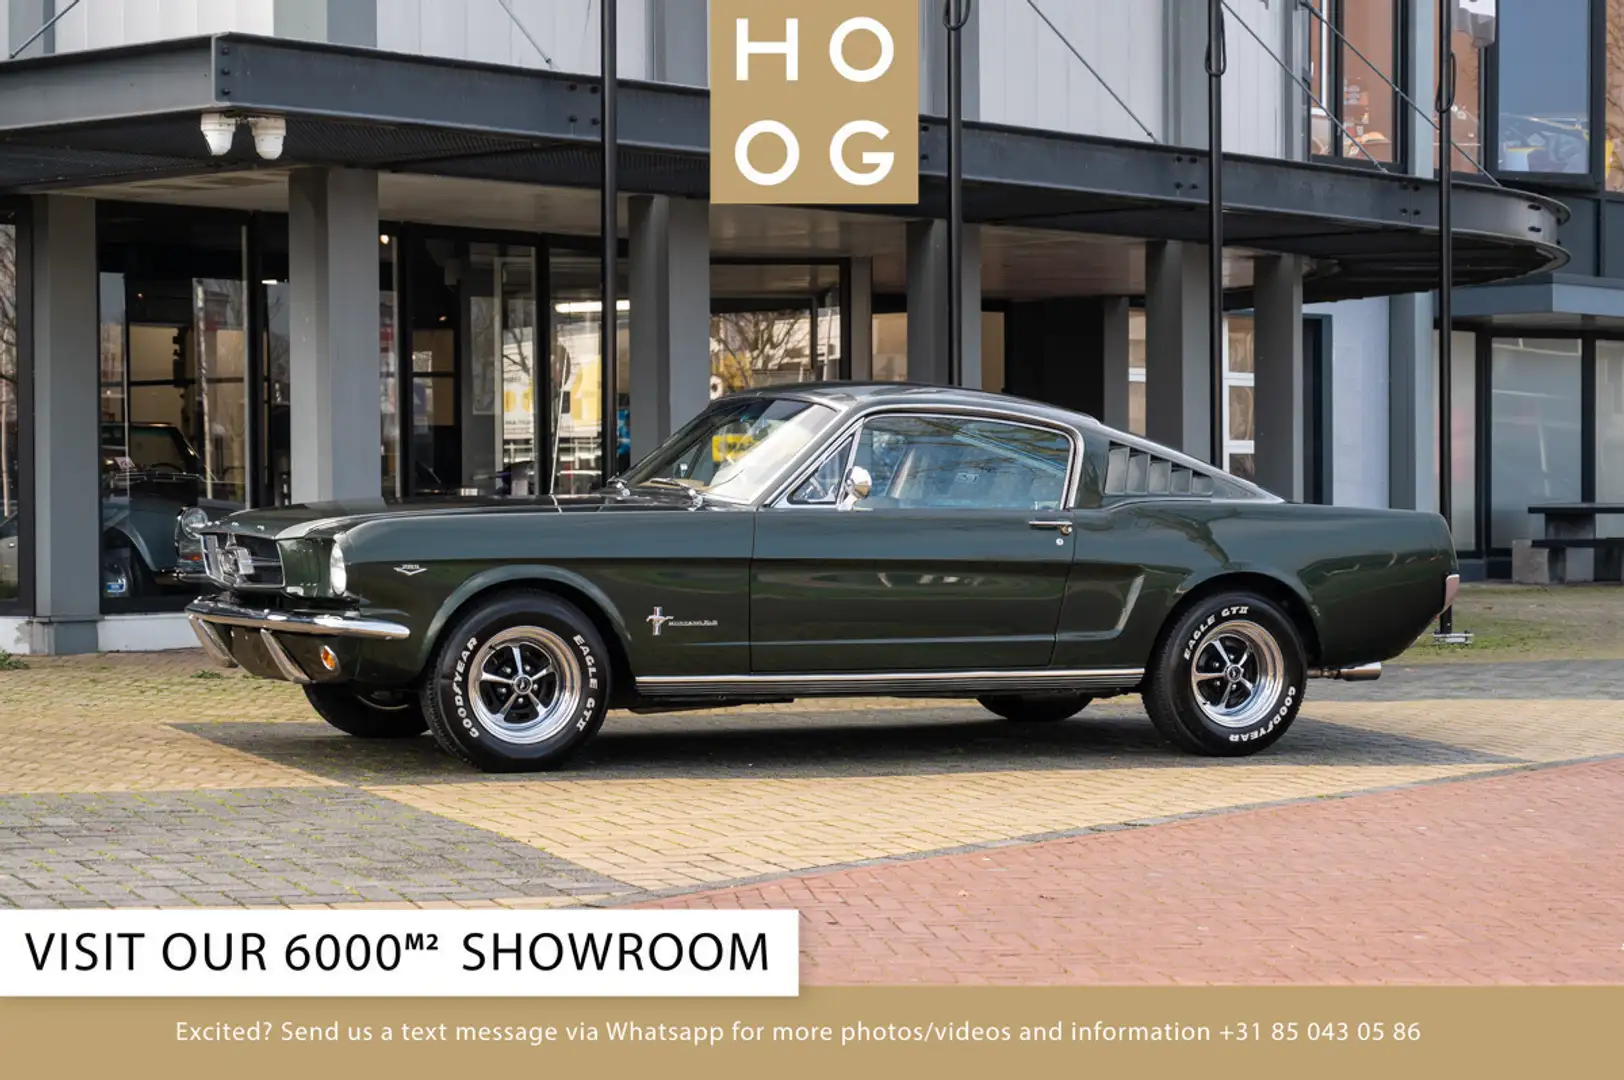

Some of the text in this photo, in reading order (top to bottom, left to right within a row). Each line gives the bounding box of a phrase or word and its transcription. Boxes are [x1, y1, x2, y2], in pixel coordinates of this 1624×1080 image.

[573, 634, 598, 690] EAGLE
[1184, 615, 1216, 661] EAGLE
[452, 636, 480, 739] GOODYEAR
[1229, 686, 1296, 742] GOODYEAR
